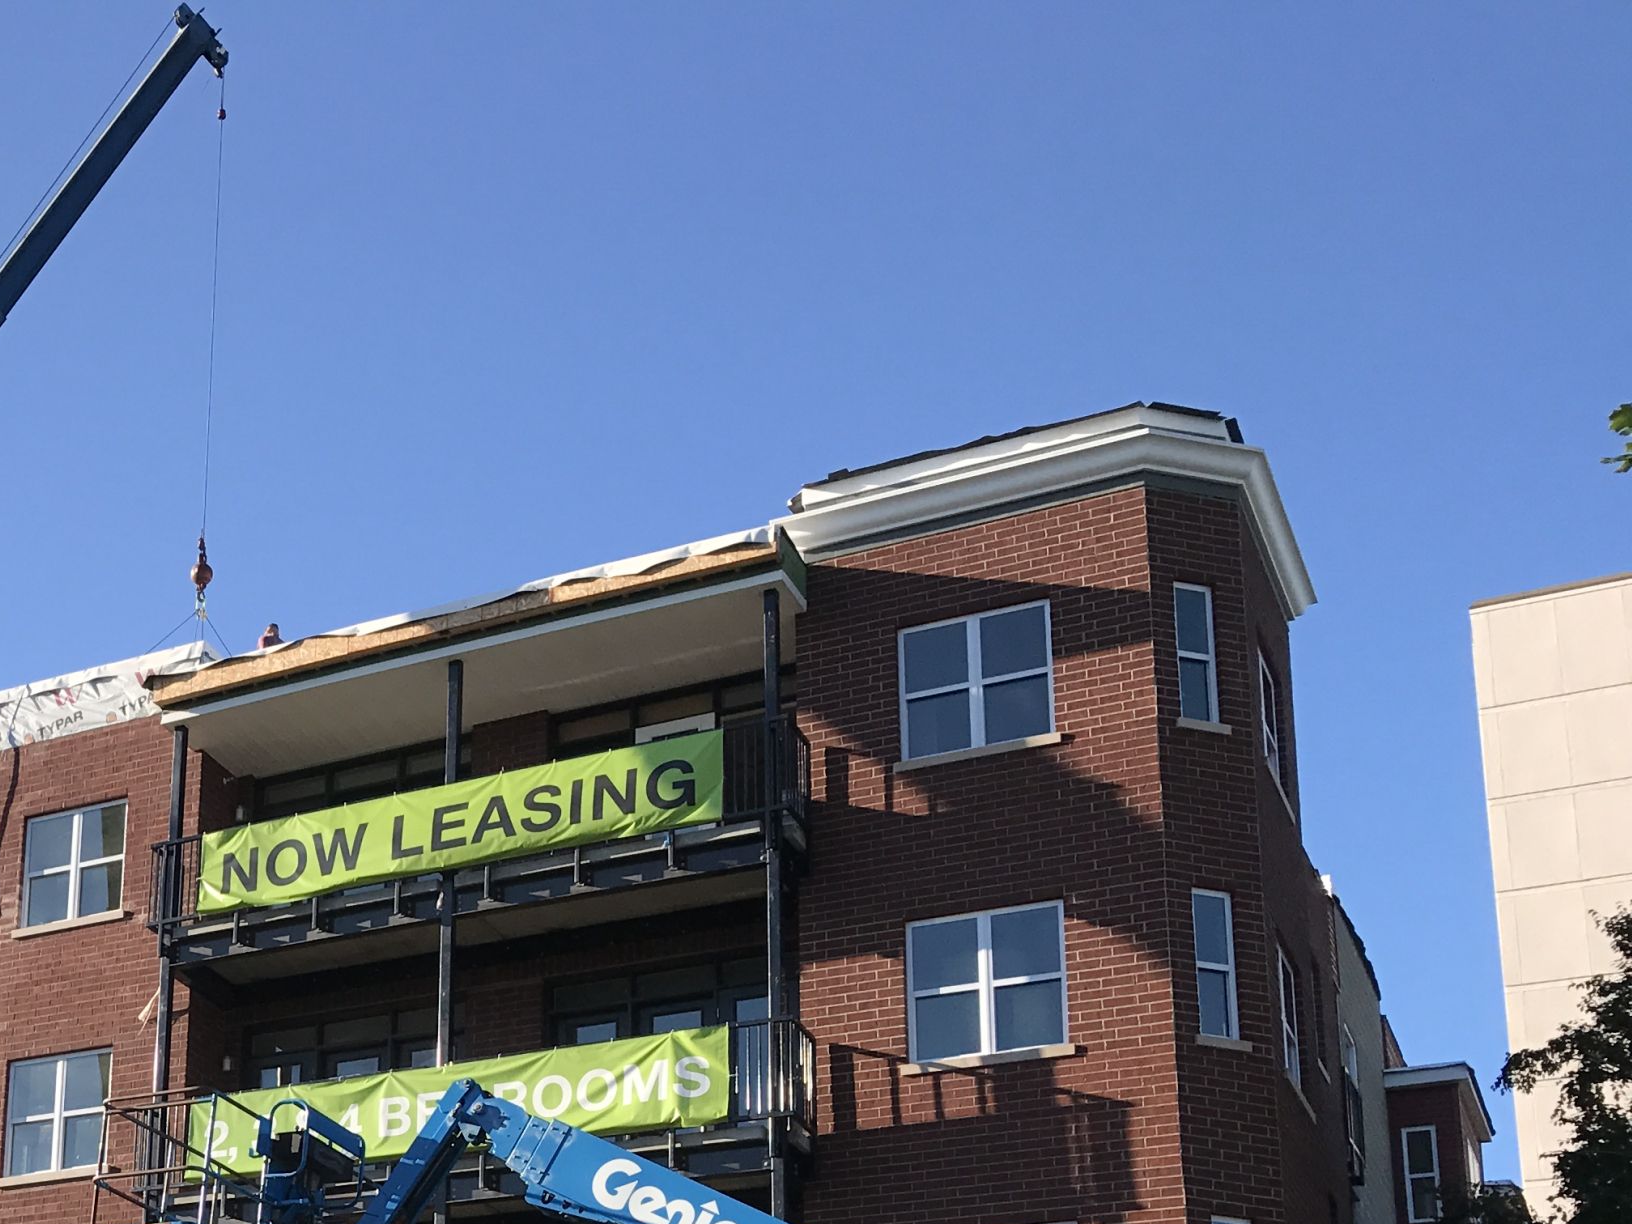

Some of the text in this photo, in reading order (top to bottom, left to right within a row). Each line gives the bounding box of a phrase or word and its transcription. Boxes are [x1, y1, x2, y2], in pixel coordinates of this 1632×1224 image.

[37, 710, 84, 740] TYPAR
[119, 692, 155, 717] TYPA
[218, 757, 697, 896] NOW LEASING
[377, 1055, 712, 1139] BEROOMS
